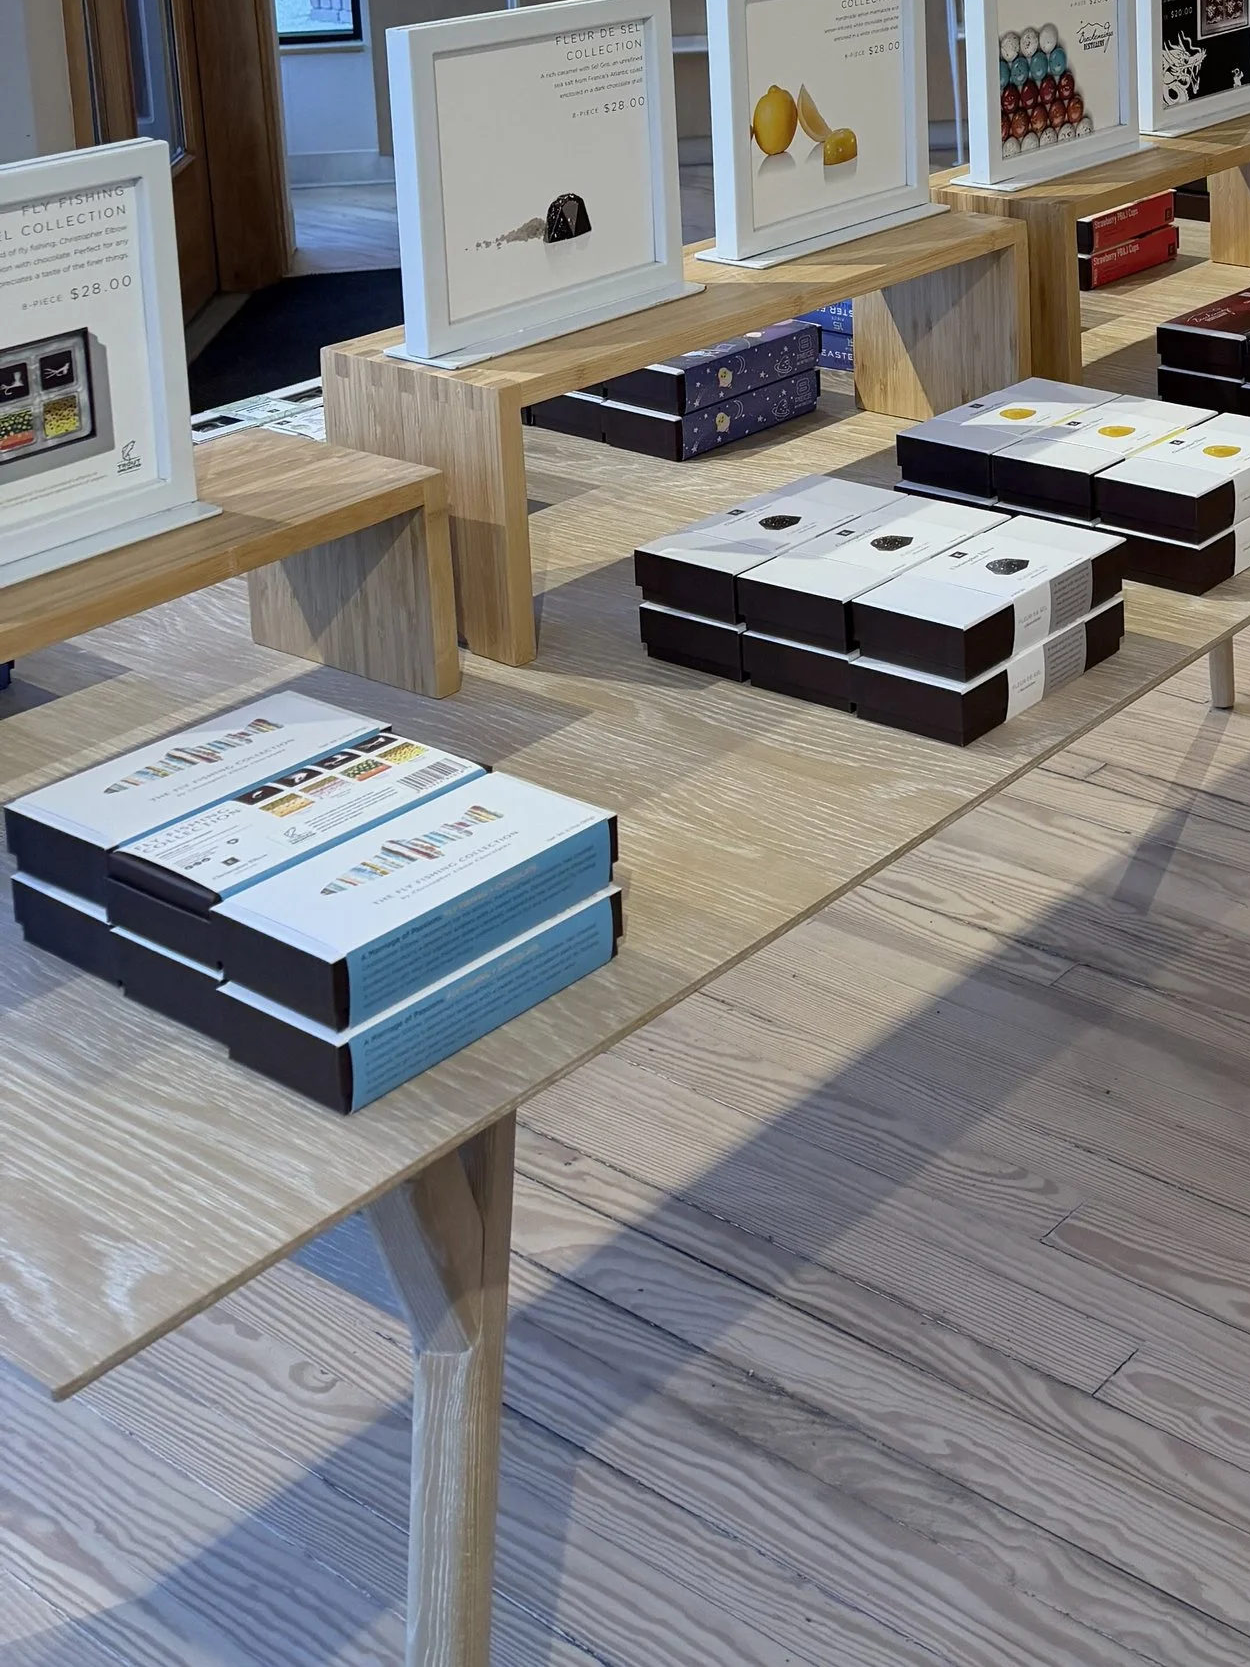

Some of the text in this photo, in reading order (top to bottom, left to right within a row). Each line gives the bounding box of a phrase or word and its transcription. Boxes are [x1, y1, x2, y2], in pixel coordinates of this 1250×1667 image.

[554, 23, 641, 46] FLEUR DE SEL
[566, 38, 643, 61] COLLECTION
[867, 40, 900, 56] $28.00
[557, 67, 579, 77] caramel
[603, 96, 646, 114] $28.00
[21, 185, 125, 217] FLY FISHING
[21, 204, 126, 237] COLLECTION
[1093, 215, 1117, 229] Strawberry
[1129, 207, 1139, 218] Cups
[59, 230, 103, 246] Christopher
[104, 224, 128, 235] Elbow
[15, 260, 32, 270] with
[73, 243, 101, 256] Perfect
[115, 238, 130, 248] any
[1092, 252, 1117, 266] Strawberry
[1128, 242, 1140, 254] Cups
[41, 268, 62, 279] taste
[72, 262, 86, 270] the
[86, 257, 105, 267] finer
[21, 275, 132, 312] 8-PIECE $28.00
[117, 458, 142, 470] TROUT
[134, 838, 158, 852] FLY
[167, 806, 231, 836] FISHING
[143, 808, 242, 854] COLLECTION
[373, 830, 520, 905] THE FLY FISHING COLLECTION
